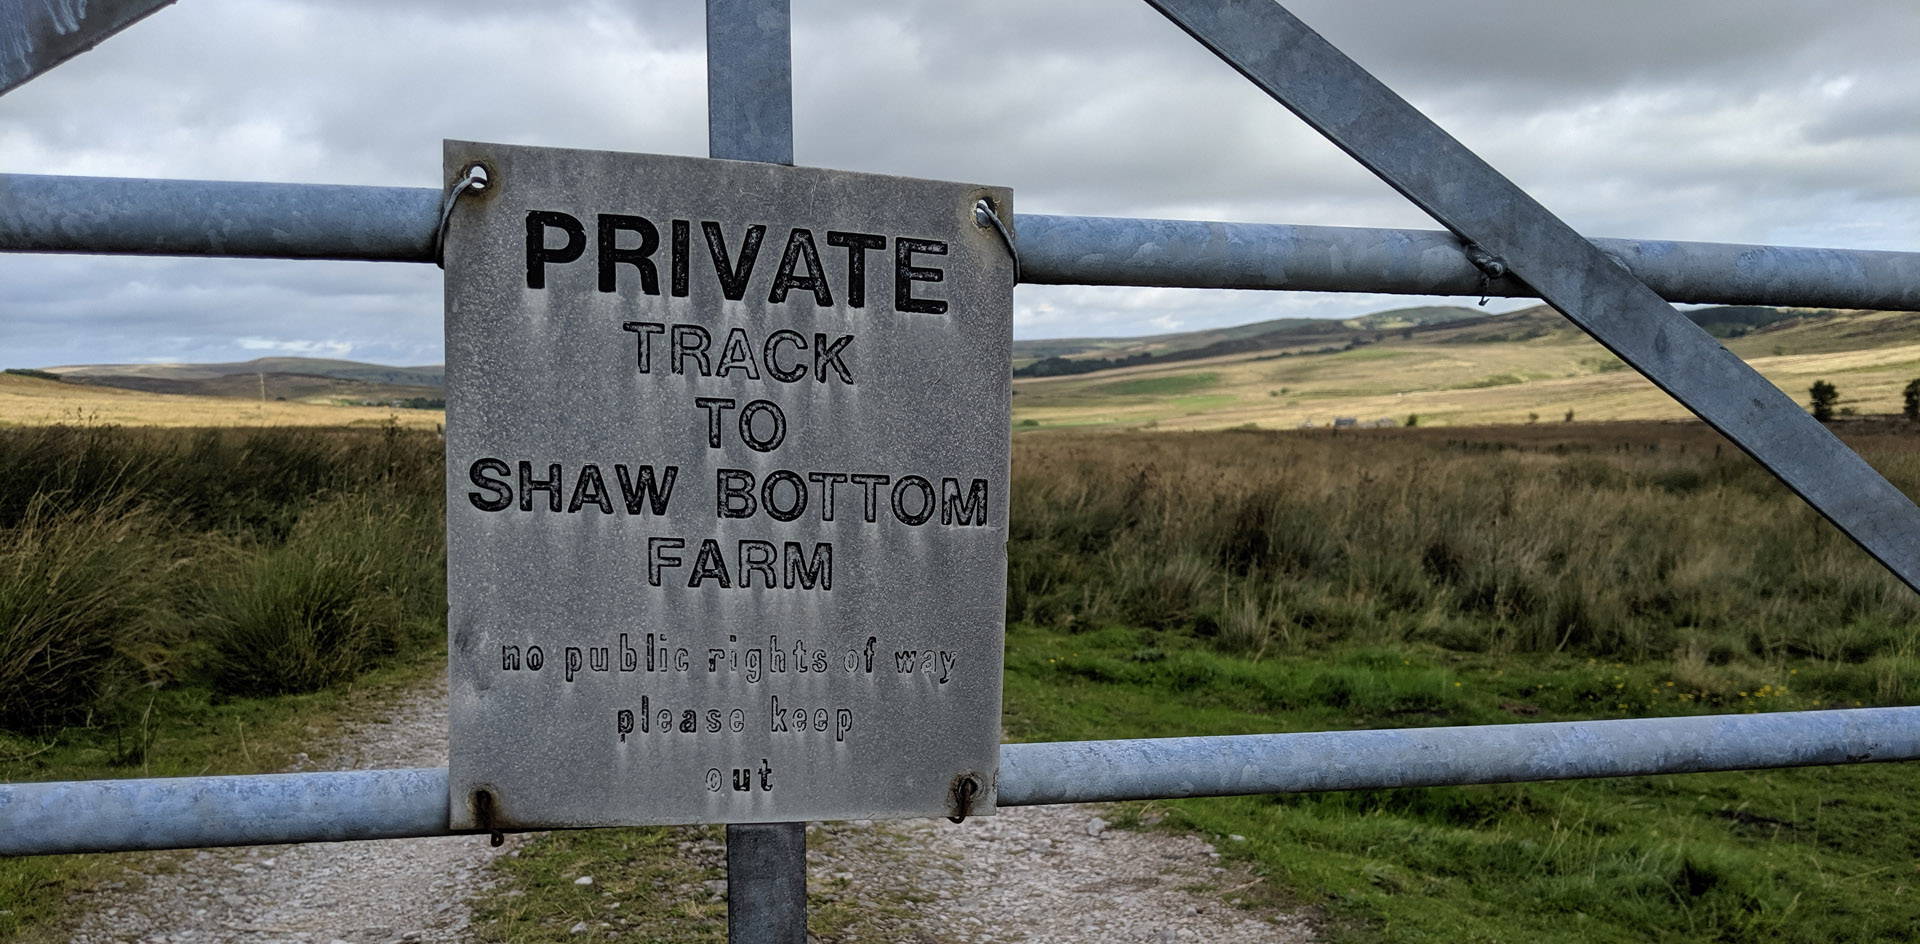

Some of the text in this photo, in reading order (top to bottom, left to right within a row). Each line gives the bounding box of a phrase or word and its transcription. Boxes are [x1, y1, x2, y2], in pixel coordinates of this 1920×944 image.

[526, 210, 949, 315] PRIVATE
[623, 321, 855, 385] TRACK
[695, 397, 787, 452] TO
[468, 457, 989, 527] SHAW BOTTOM
[648, 537, 833, 591] FARM
[502, 633, 957, 684] no public rights of way
[617, 696, 853, 743] please keep
[705, 759, 773, 792] out
